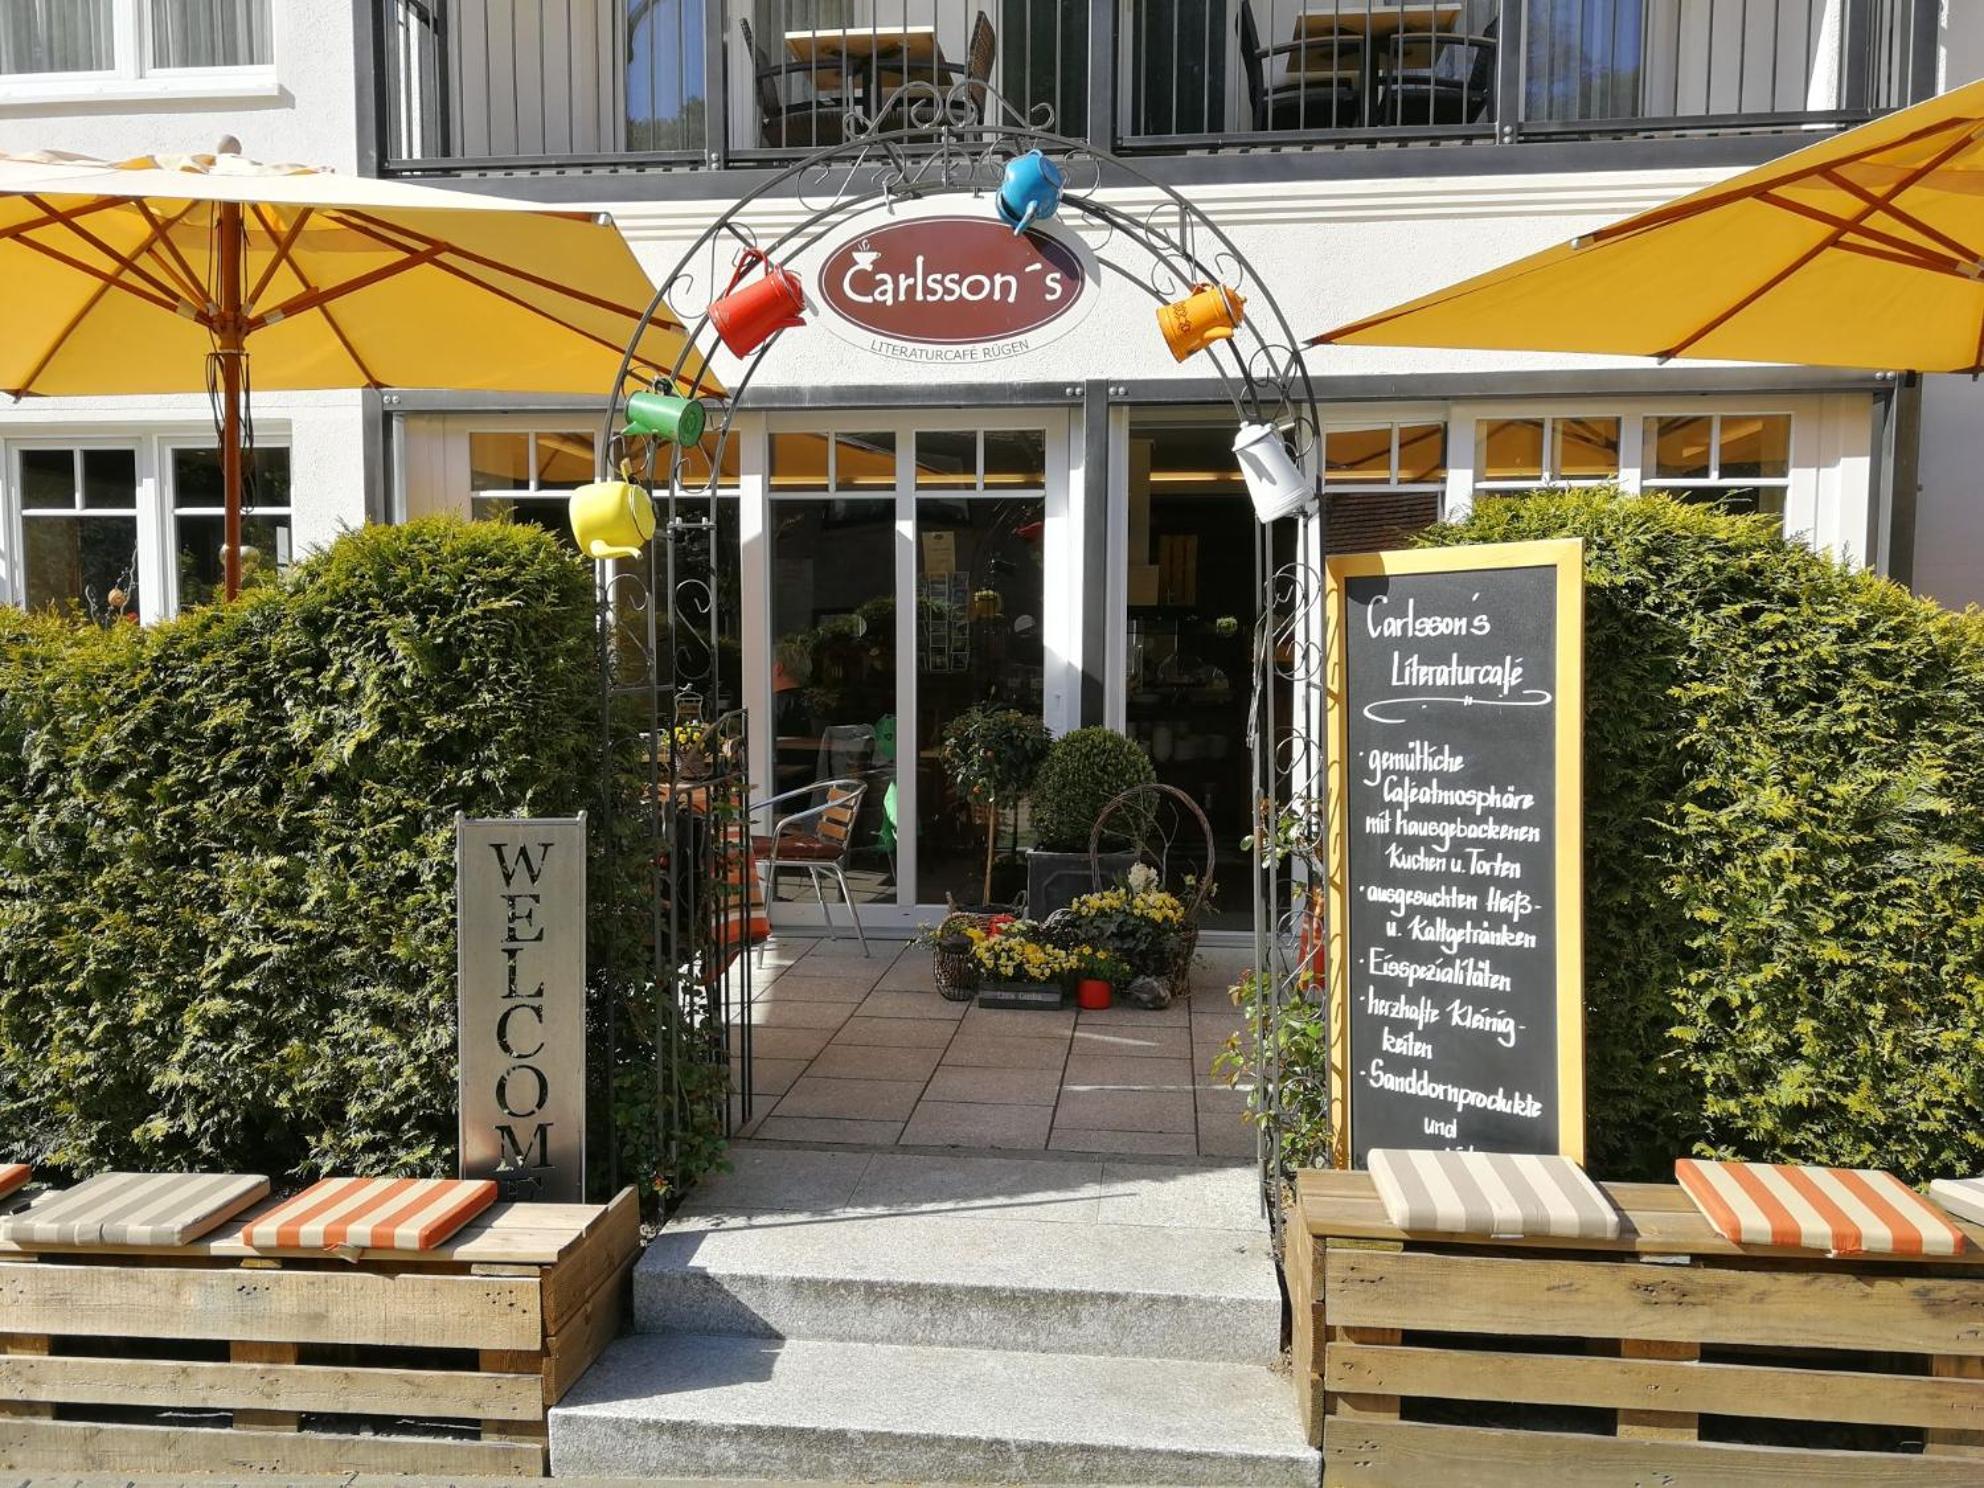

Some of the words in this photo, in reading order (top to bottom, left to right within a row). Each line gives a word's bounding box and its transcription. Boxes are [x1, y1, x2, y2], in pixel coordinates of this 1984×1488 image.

[870, 339, 978, 361] LITERATURCAFÉ
[983, 338, 1029, 359] RÜGEN
[1391, 650, 1524, 695] Literaturcafé
[1363, 740, 1465, 786] gemütliche
[1383, 775, 1535, 816] Caféatmosphäre
[1365, 809, 1393, 834] mit
[1395, 808, 1541, 852] hausgebackenen
[1385, 843, 1447, 870] Kuchen
[1451, 861, 1467, 873] u.
[1465, 848, 1521, 879] Torten
[1367, 885, 1478, 917] ausgesuchten
[1486, 886, 1542, 922] Heiß-
[1386, 921, 1402, 937] u.
[1407, 915, 1537, 954] Kaltgetränken
[1369, 947, 1512, 992] Eisspezialitäten
[1367, 985, 1440, 1031] herzhafte
[1382, 1026, 1433, 1059] keiten
[1369, 1059, 1543, 1117] Sanddornprodukte
[1423, 1116, 1457, 1139] und
